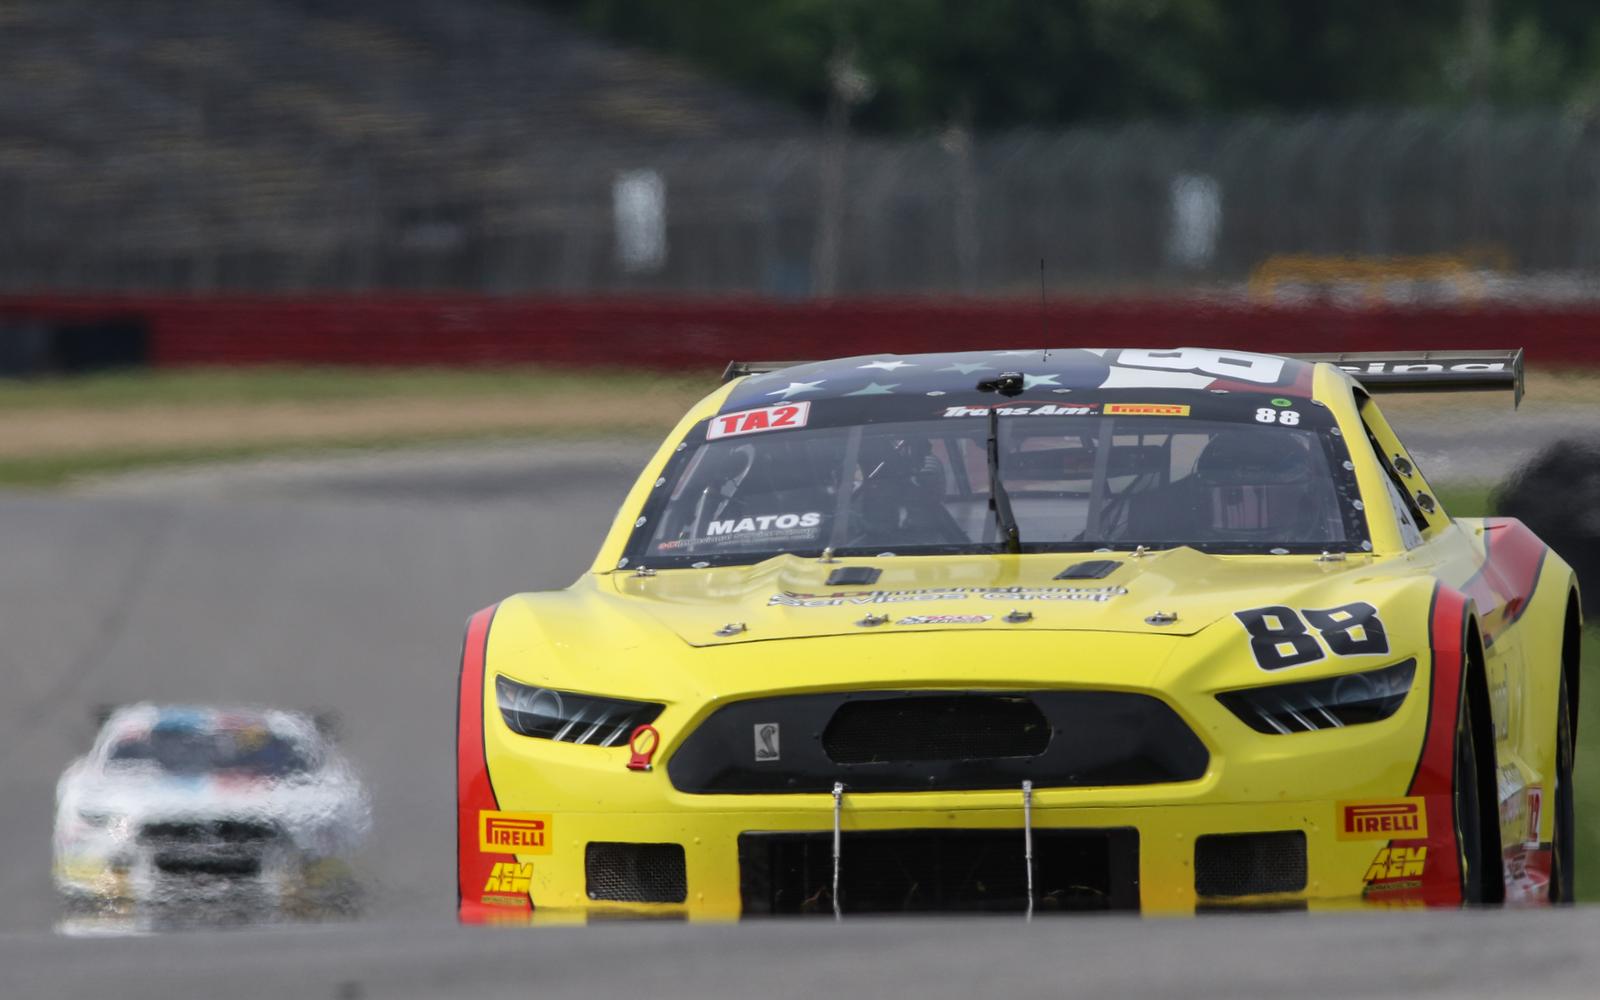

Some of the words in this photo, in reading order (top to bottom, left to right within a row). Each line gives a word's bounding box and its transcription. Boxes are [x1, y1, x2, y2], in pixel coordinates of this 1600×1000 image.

[720, 406, 799, 434] TA2
[943, 405, 1031, 417] Trans
[1029, 404, 1091, 415] Am
[1111, 405, 1182, 414] PIRELLI
[1255, 407, 1300, 426] 88
[706, 512, 821, 536] MATOS
[1233, 601, 1390, 671] 88
[486, 817, 544, 847] PIRELLI
[1344, 803, 1419, 833] PIRELLI
[484, 862, 534, 893] AEM
[1363, 846, 1428, 881] AEM
